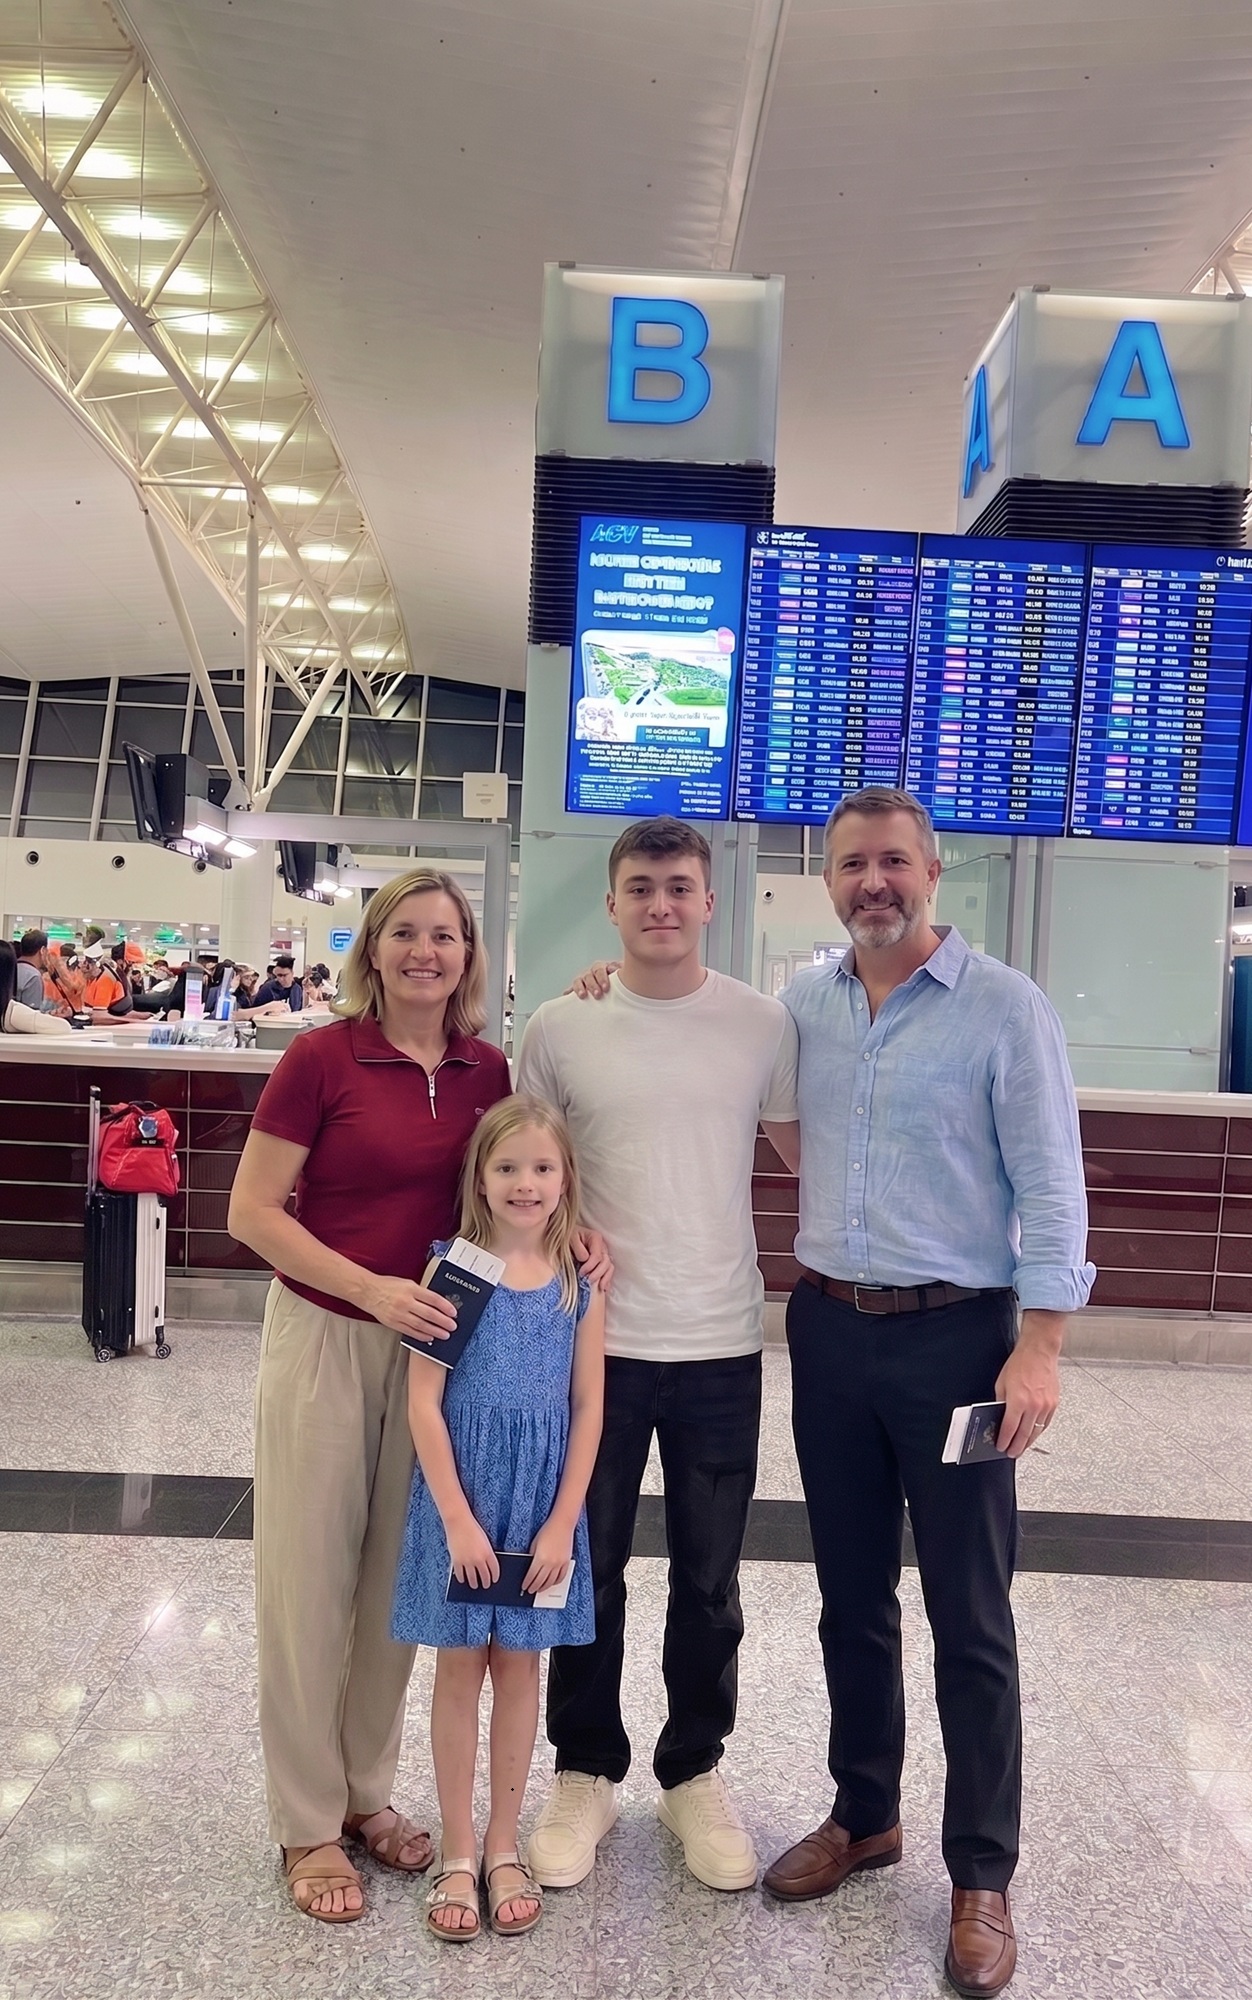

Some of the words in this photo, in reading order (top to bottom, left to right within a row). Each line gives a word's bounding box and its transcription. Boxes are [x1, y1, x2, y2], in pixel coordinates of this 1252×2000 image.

[608, 296, 711, 425] B
[1076, 320, 1190, 449] A
[963, 364, 989, 499] A
